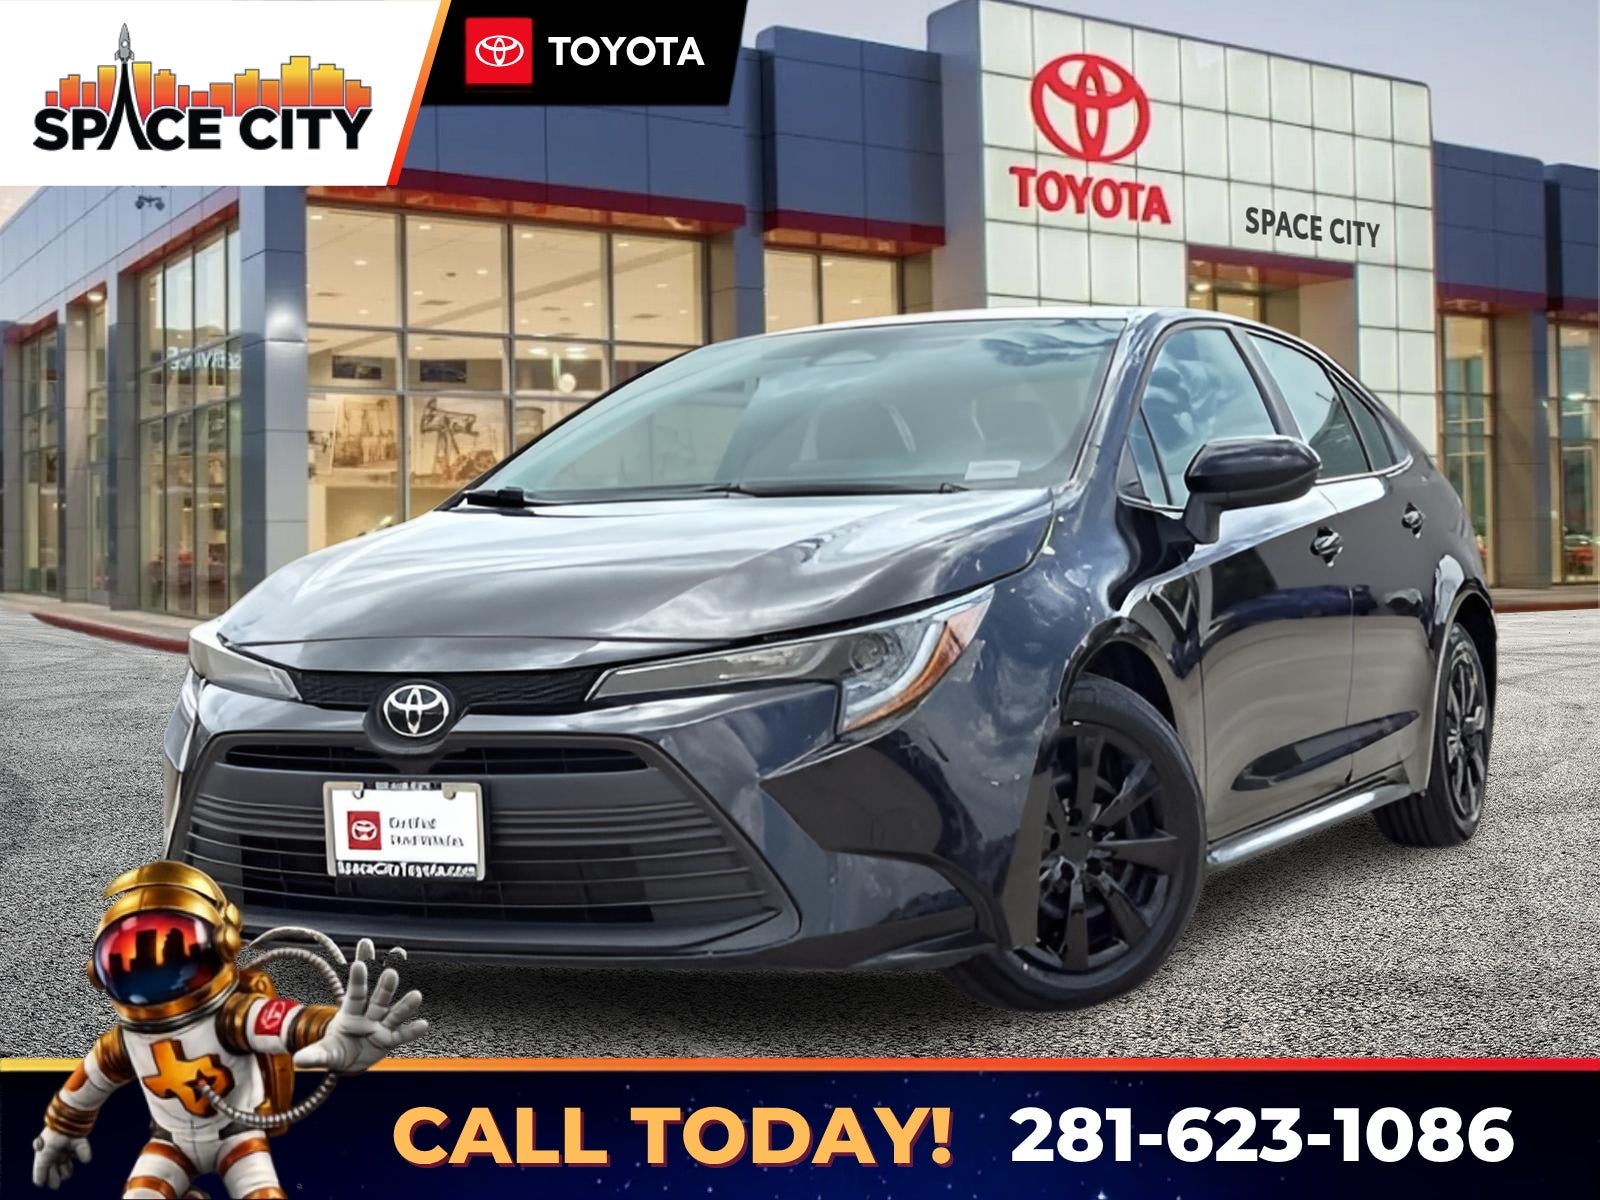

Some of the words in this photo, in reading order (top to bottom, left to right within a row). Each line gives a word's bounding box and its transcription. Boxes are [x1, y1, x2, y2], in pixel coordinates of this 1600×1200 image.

[1008, 166, 1171, 224] TOYOTA
[1245, 206, 1323, 242] SPACE
[1329, 217, 1381, 248] CITY
